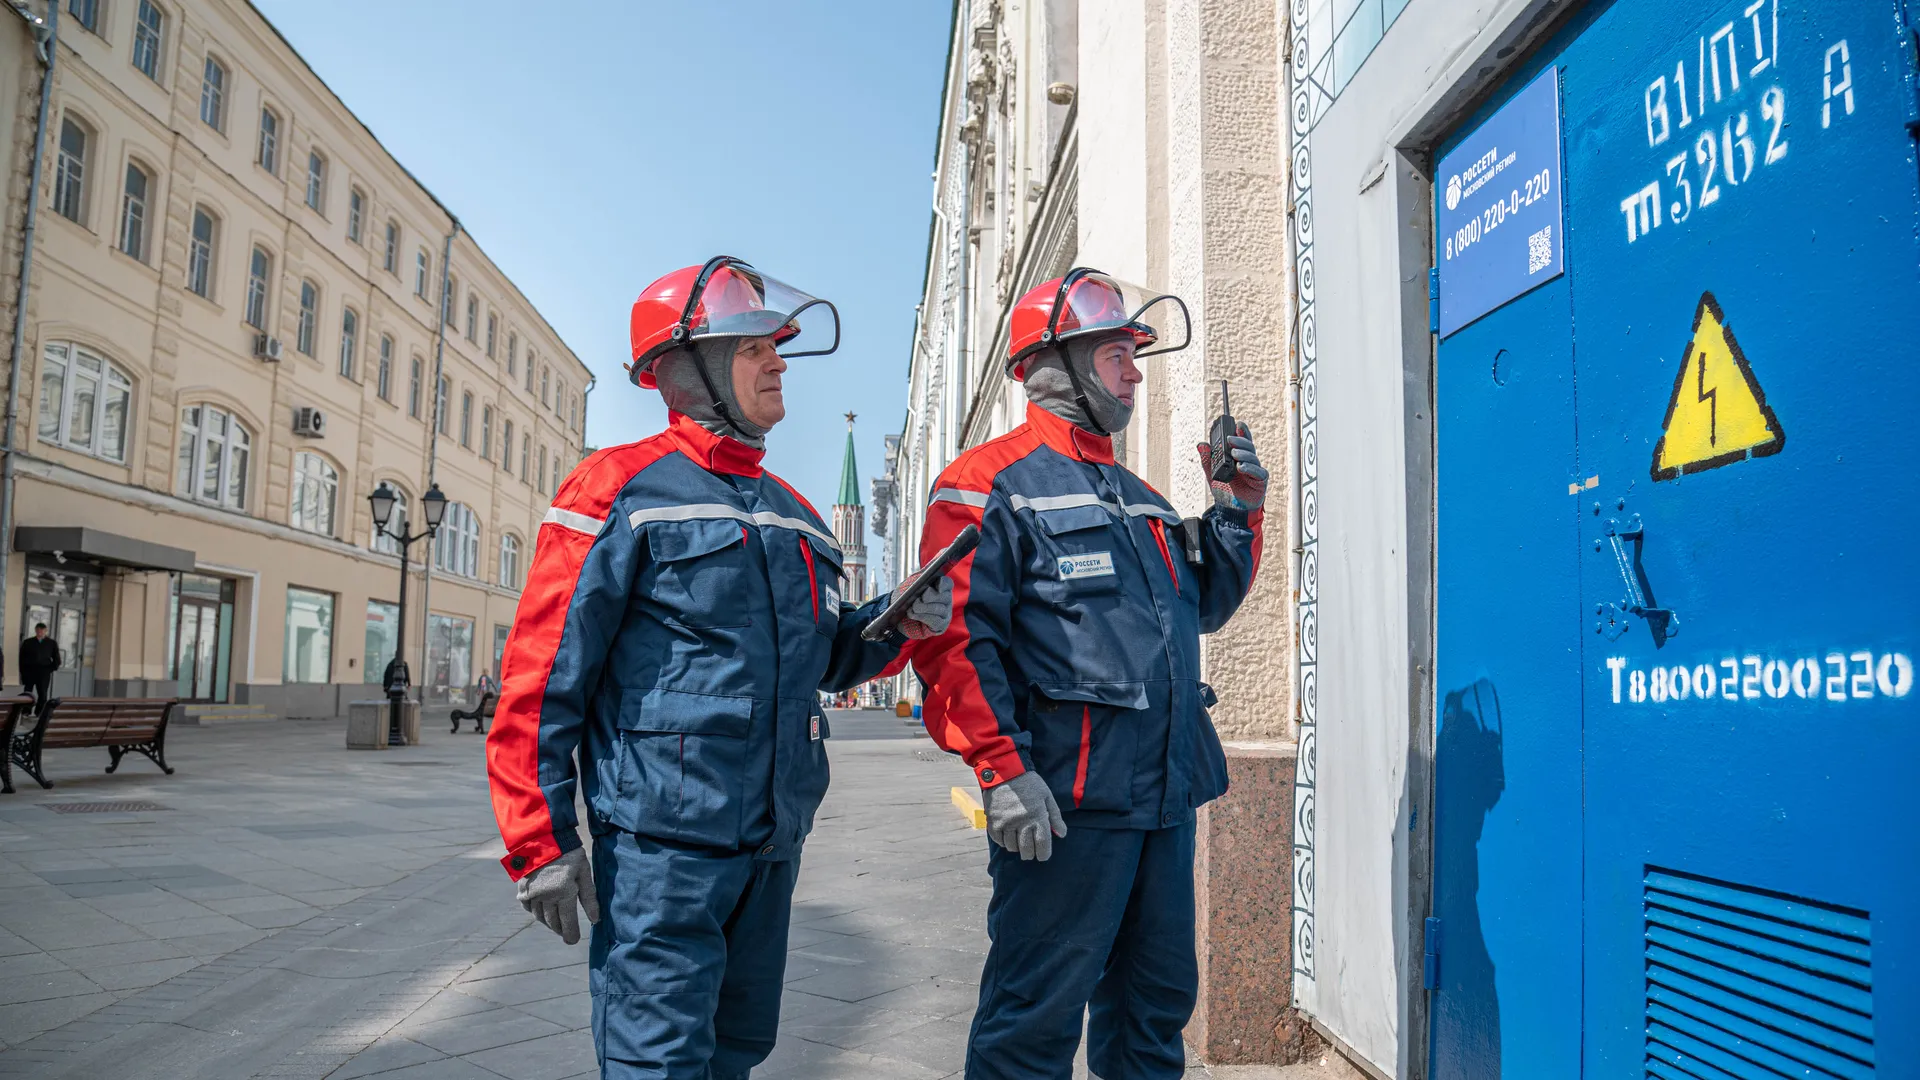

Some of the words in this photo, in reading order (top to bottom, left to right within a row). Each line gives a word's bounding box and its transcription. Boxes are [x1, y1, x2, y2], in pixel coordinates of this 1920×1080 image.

[1463, 147, 1497, 186] РОССЕТИ
[1463, 166, 1495, 200] МОСКОВСКИЙ
[1495, 151, 1516, 175] РЕГИОН
[1446, 237, 1452, 261] 8
[1455, 216, 1482, 257] (800)
[1484, 168, 1550, 234] 220-0-220
[1074, 559, 1101, 567] РОССЕТИ
